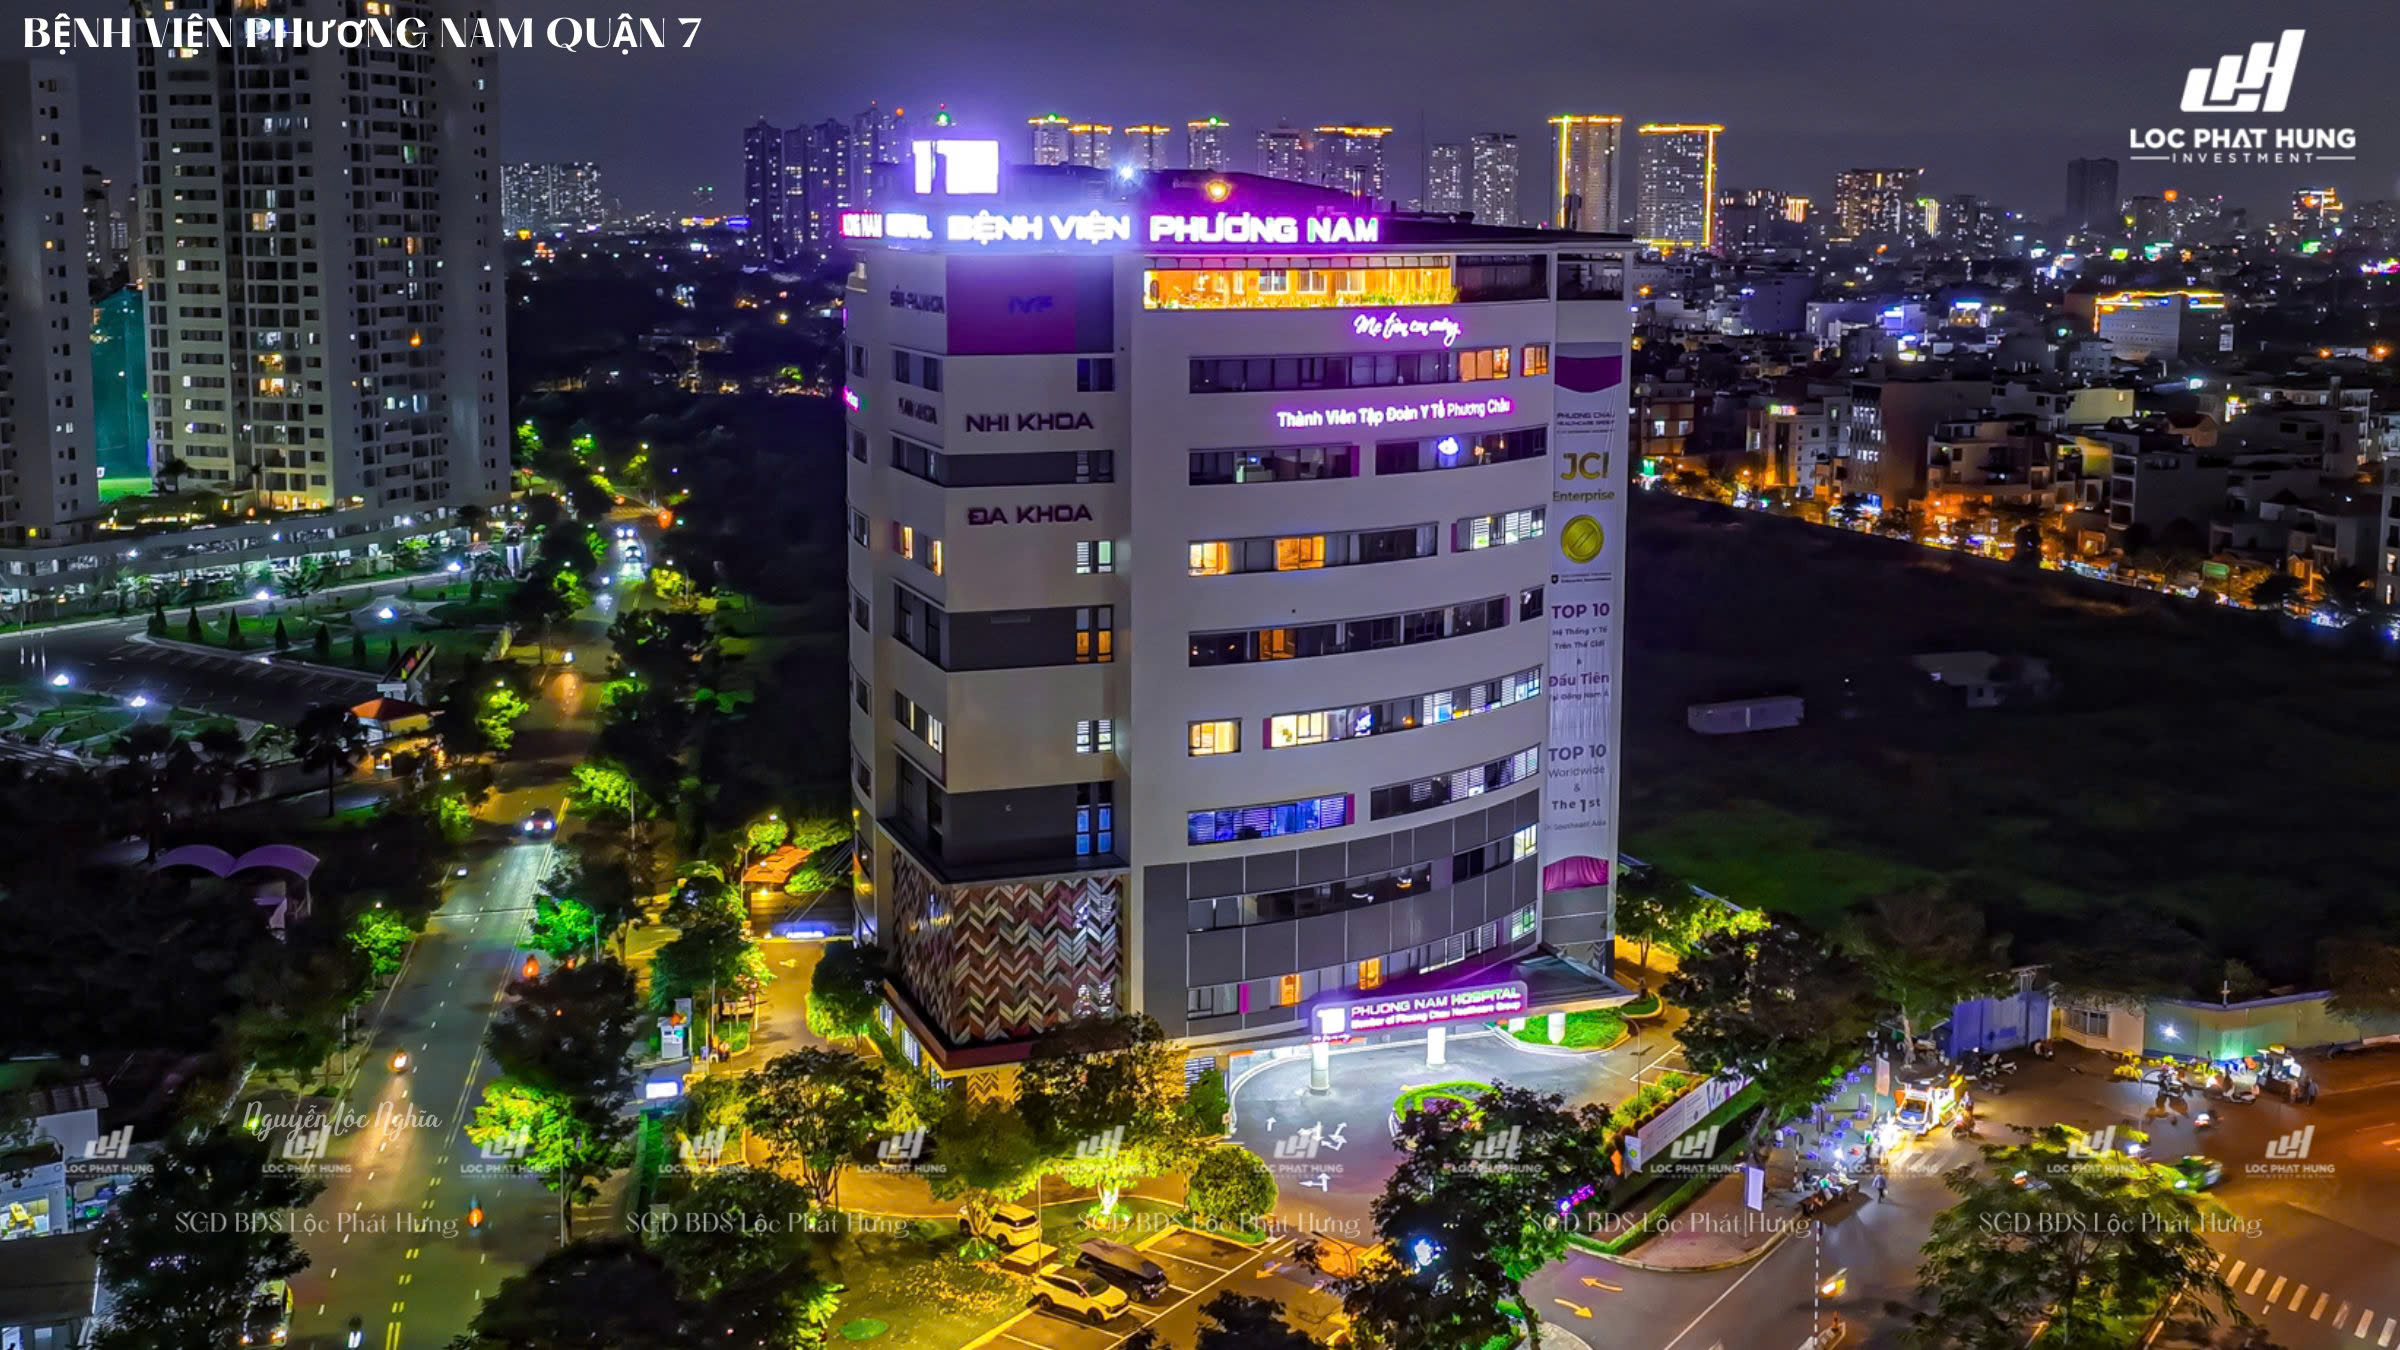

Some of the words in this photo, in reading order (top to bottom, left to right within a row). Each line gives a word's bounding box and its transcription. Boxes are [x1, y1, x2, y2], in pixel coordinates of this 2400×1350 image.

[1307, 216, 1379, 243] NAM
[1420, 404, 1430, 419] Y
[965, 414, 1010, 433] NHI
[1017, 411, 1095, 432] KHOA
[1560, 451, 1610, 481] JCI
[1552, 489, 1616, 503] Enterprise
[967, 506, 1009, 526] ĐA
[1016, 503, 1093, 525] KHOA
[1551, 604, 1588, 619] TOP
[1592, 602, 1610, 617] 10
[1547, 746, 1584, 762] TOP
[1588, 744, 1607, 758] 10
[1548, 765, 1606, 778] Worldwide
[1573, 782, 1581, 792] &
[1551, 800, 1576, 810] The
[1414, 996, 1448, 1010] NAM
